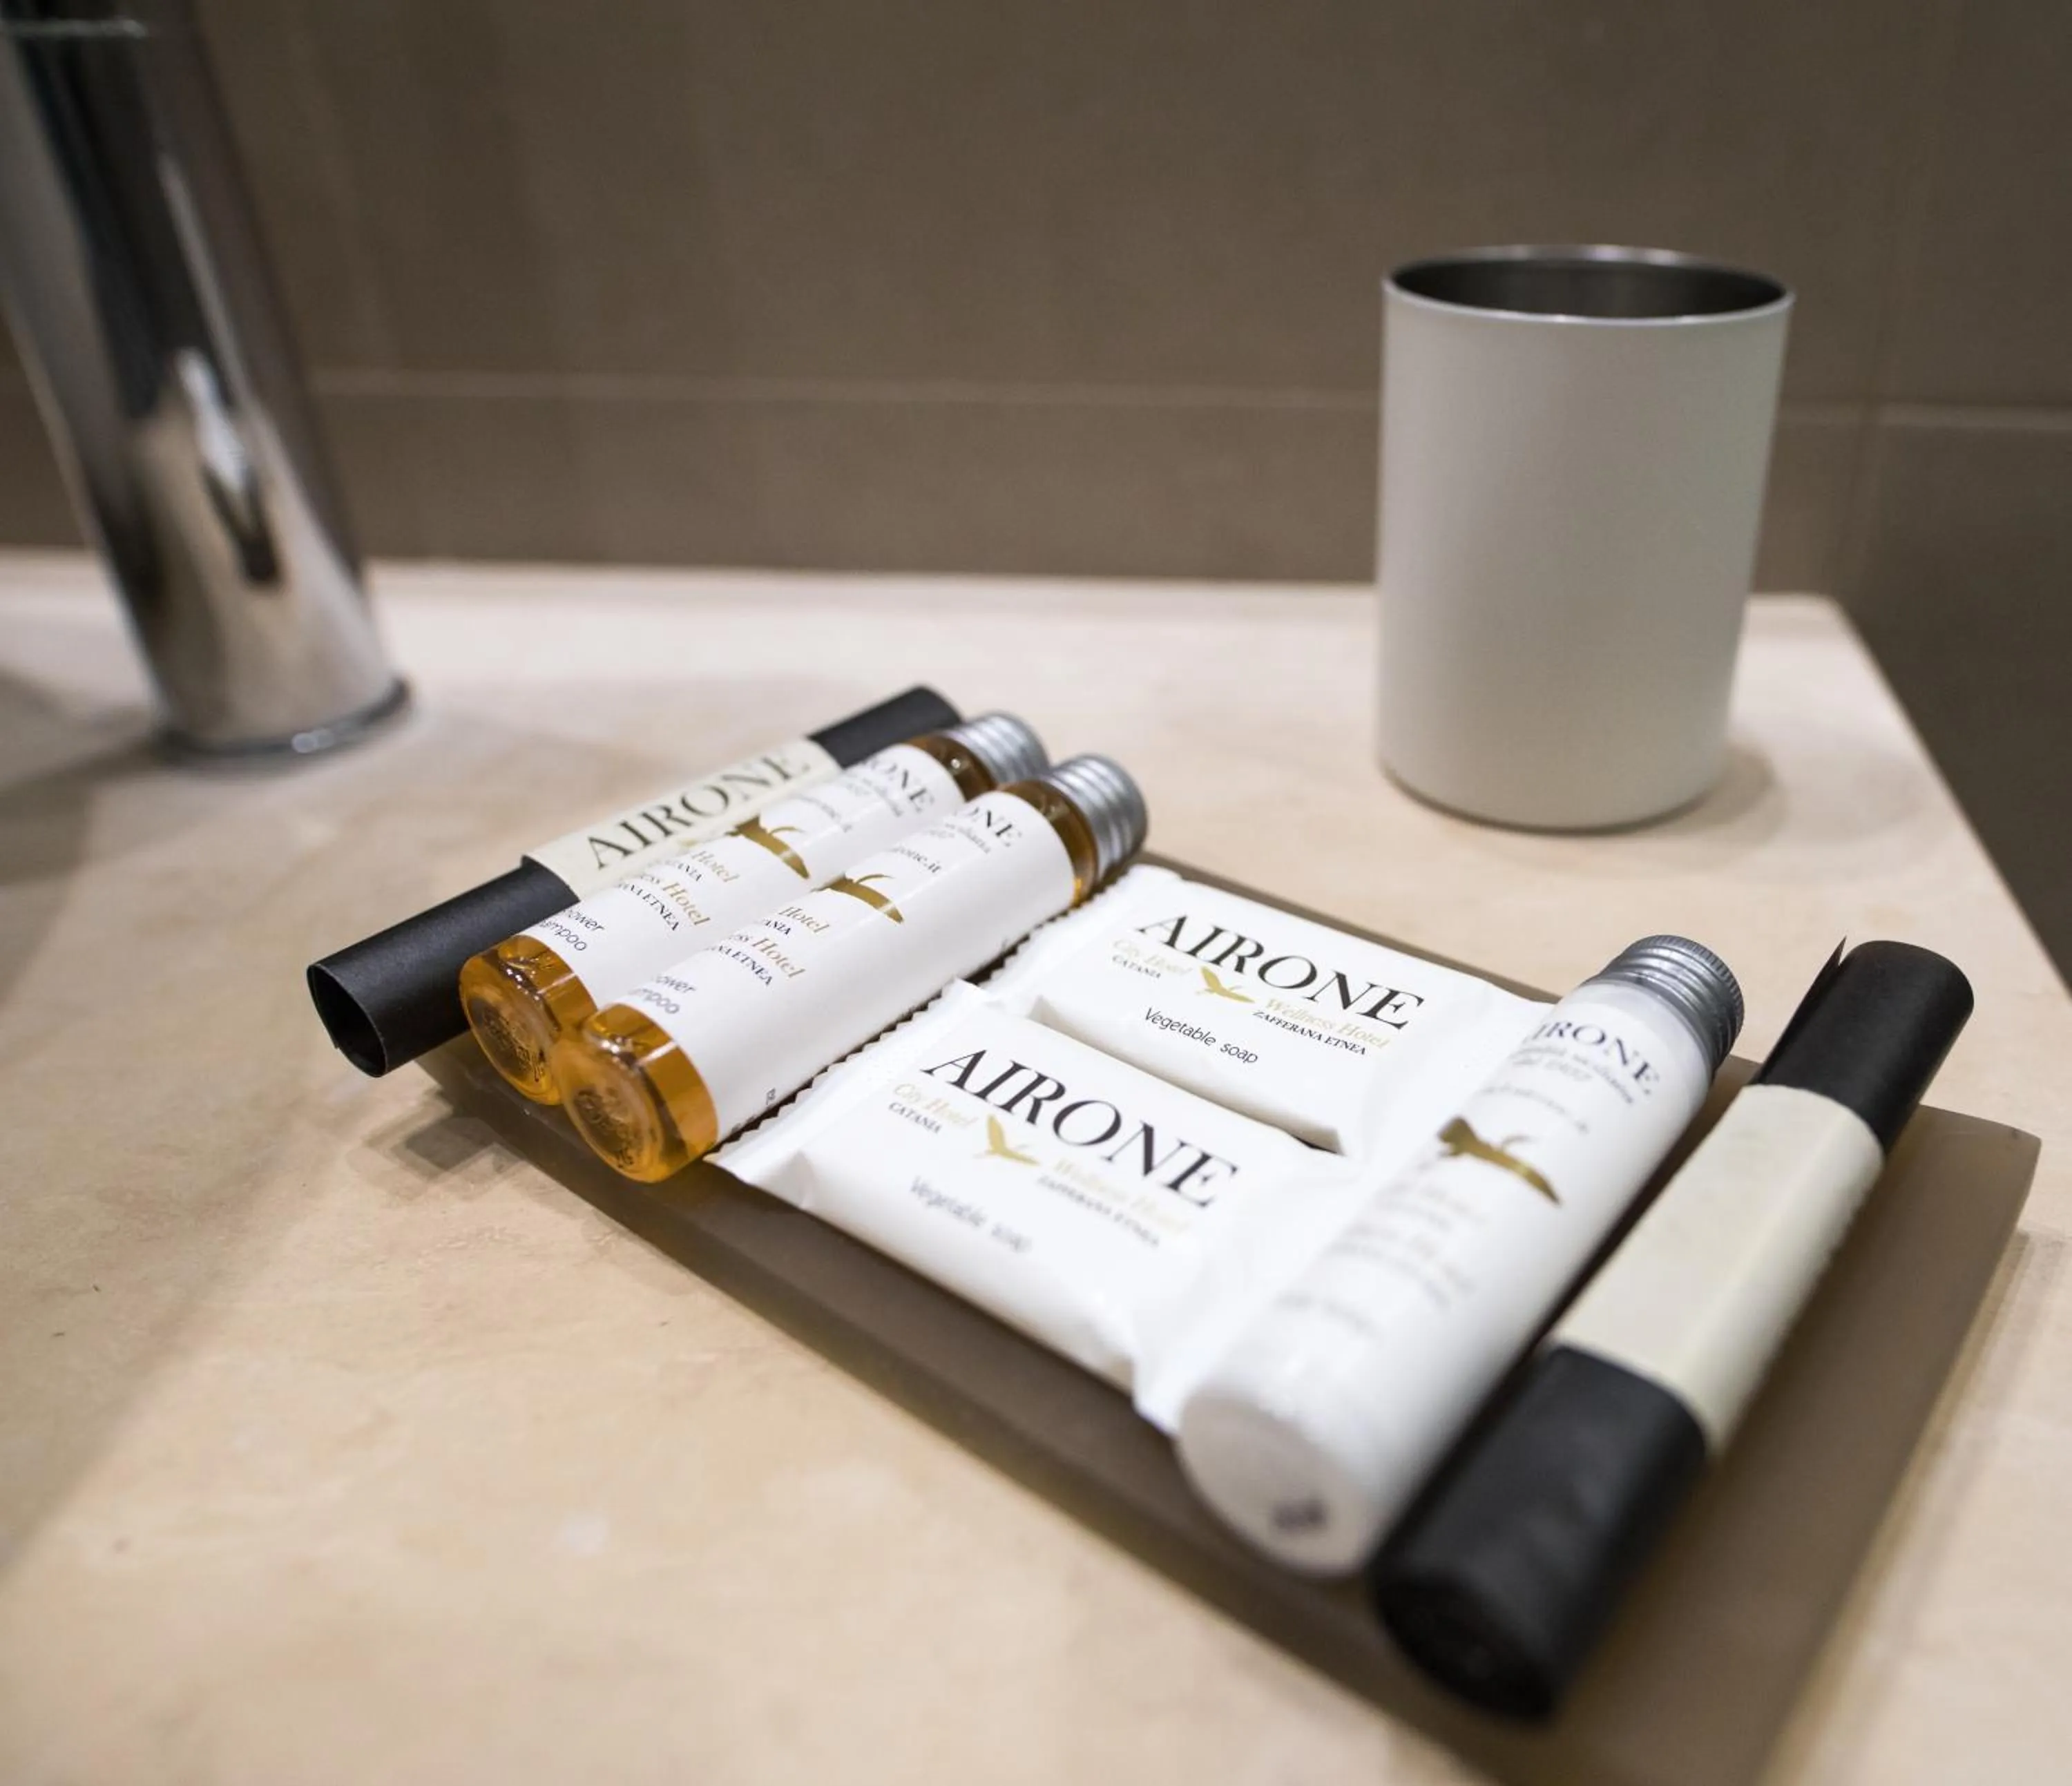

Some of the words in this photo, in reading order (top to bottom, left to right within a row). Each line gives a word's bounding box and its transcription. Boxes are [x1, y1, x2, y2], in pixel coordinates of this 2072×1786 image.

[588, 757, 811, 870] AIRONE
[691, 850, 740, 883] Hotel
[567, 909, 605, 931] ower
[642, 893, 680, 931] ETNEA
[662, 882, 711, 925] Hotel
[778, 906, 830, 934] Hotel
[731, 950, 773, 986] ETNEA
[751, 931, 806, 978] Hotel
[1112, 954, 1161, 979] CATANIA
[1135, 914, 1425, 1030] AIRONE
[655, 974, 696, 993] ower
[1144, 1006, 1216, 1047] Vegetable
[1220, 1041, 1258, 1064] soap
[1253, 1010, 1322, 1041] ZAFFERANA
[1324, 1036, 1365, 1055] ETNEA
[1266, 999, 1335, 1030] Wellness
[1338, 1023, 1391, 1049] Hotel
[1531, 1021, 1660, 1095] IRONE
[888, 1102, 942, 1134] CATANIA
[920, 1049, 1240, 1209] AIRONE
